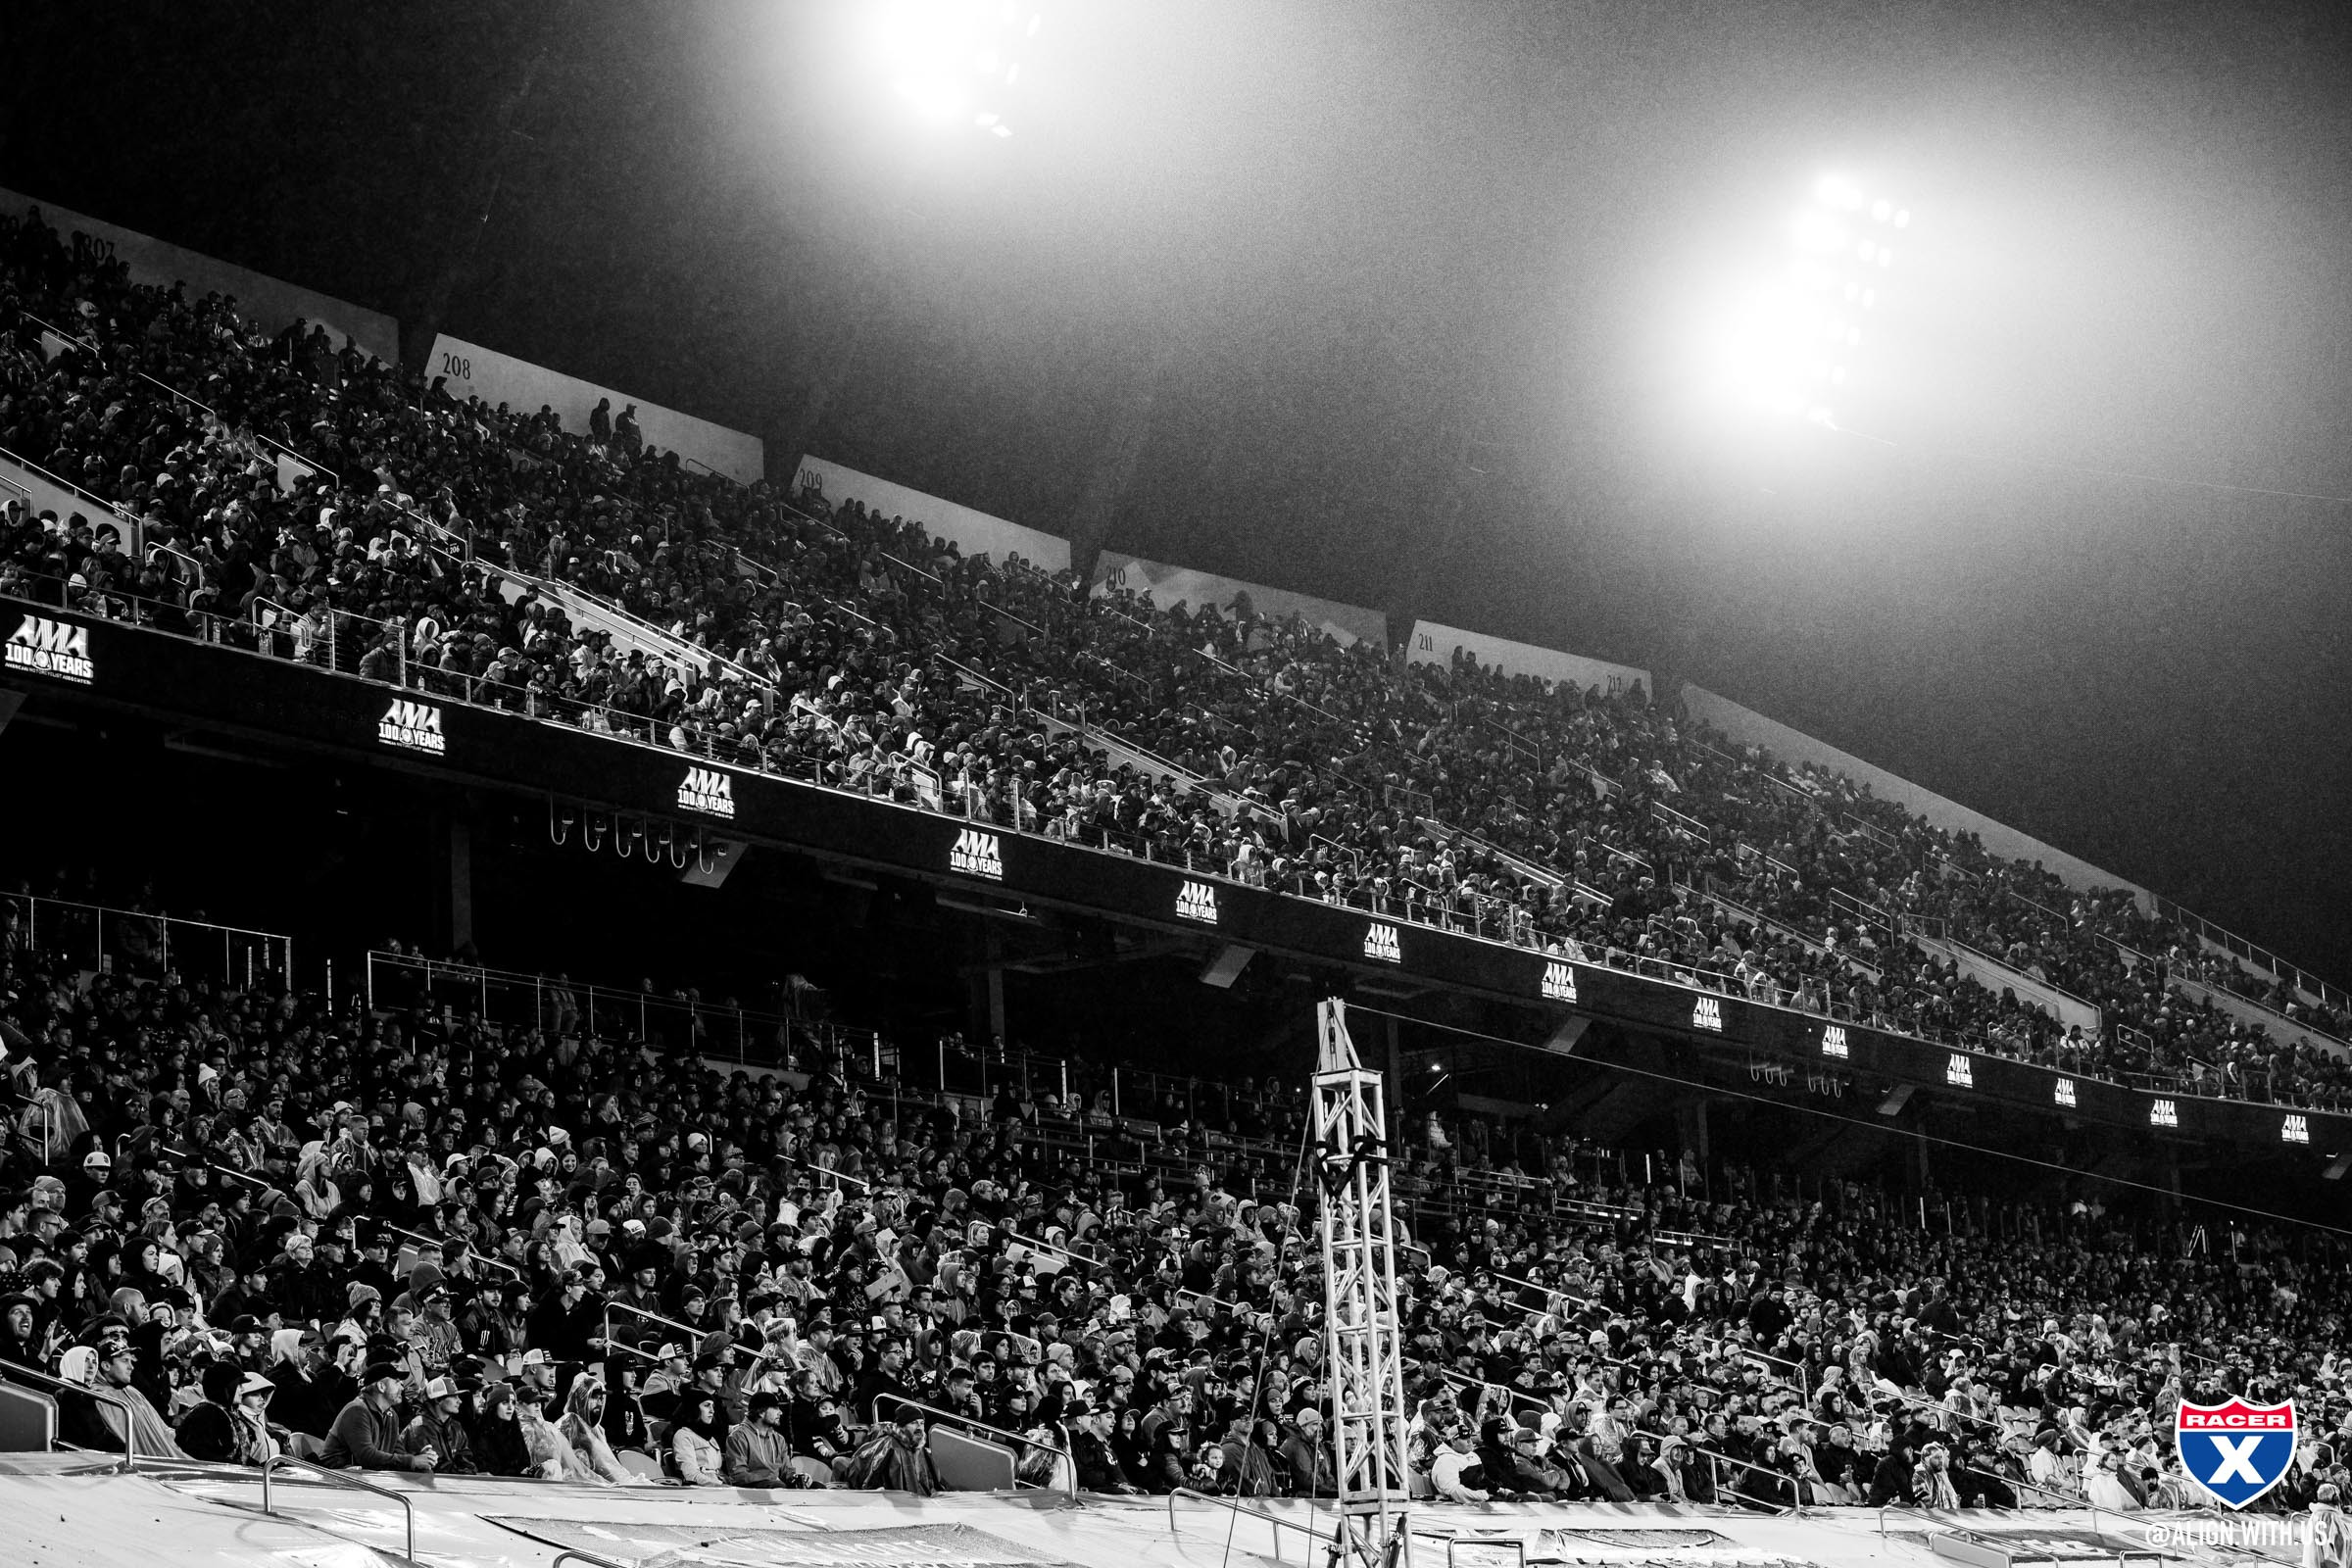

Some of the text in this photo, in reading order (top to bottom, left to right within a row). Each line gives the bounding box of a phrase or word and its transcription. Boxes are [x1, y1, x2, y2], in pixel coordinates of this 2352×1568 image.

[443, 352, 471, 380] 208
[800, 468, 823, 490] 209
[6, 614, 92, 660] AMA
[1418, 633, 1434, 652] 211
[5, 642, 94, 679] 100 YEARS
[379, 698, 444, 735] AMA
[378, 721, 399, 741] 100
[412, 727, 446, 751] YEARS
[678, 765, 733, 801] AMA
[677, 788, 697, 806] 100
[706, 794, 735, 814] YEARS
[951, 828, 1001, 861] AMA
[950, 851, 967, 868] 100
[977, 855, 1003, 875] YEARS
[1176, 880, 1216, 908] AMA
[1176, 900, 1189, 914] 100
[1197, 905, 1217, 920] YEARS
[1364, 941, 1376, 955] 100
[1383, 944, 1401, 959] YEARS
